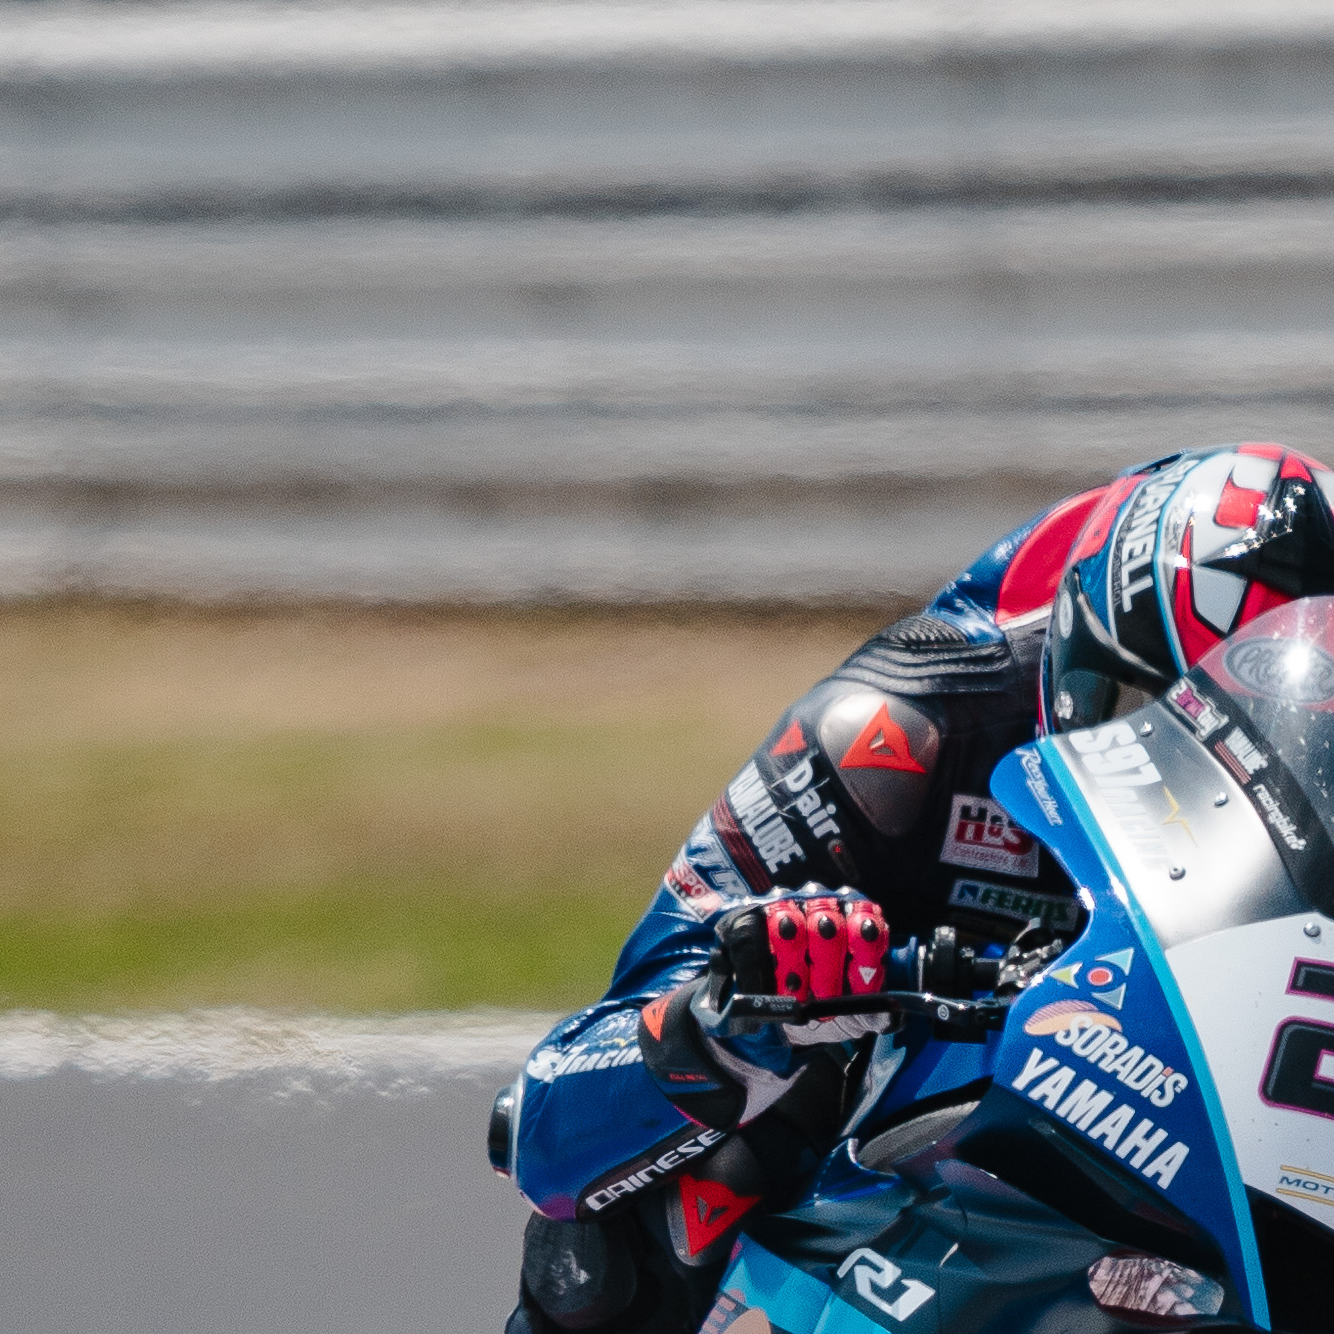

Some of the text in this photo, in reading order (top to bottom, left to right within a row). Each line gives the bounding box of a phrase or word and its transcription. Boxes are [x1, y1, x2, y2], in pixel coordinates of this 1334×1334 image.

[1069, 720, 1162, 788] S97
[955, 804, 1035, 856] H&S
[1011, 1046, 1190, 1190] YAMAHA
[585, 1128, 727, 1211] DAINESE
[836, 1247, 936, 1322] R1
